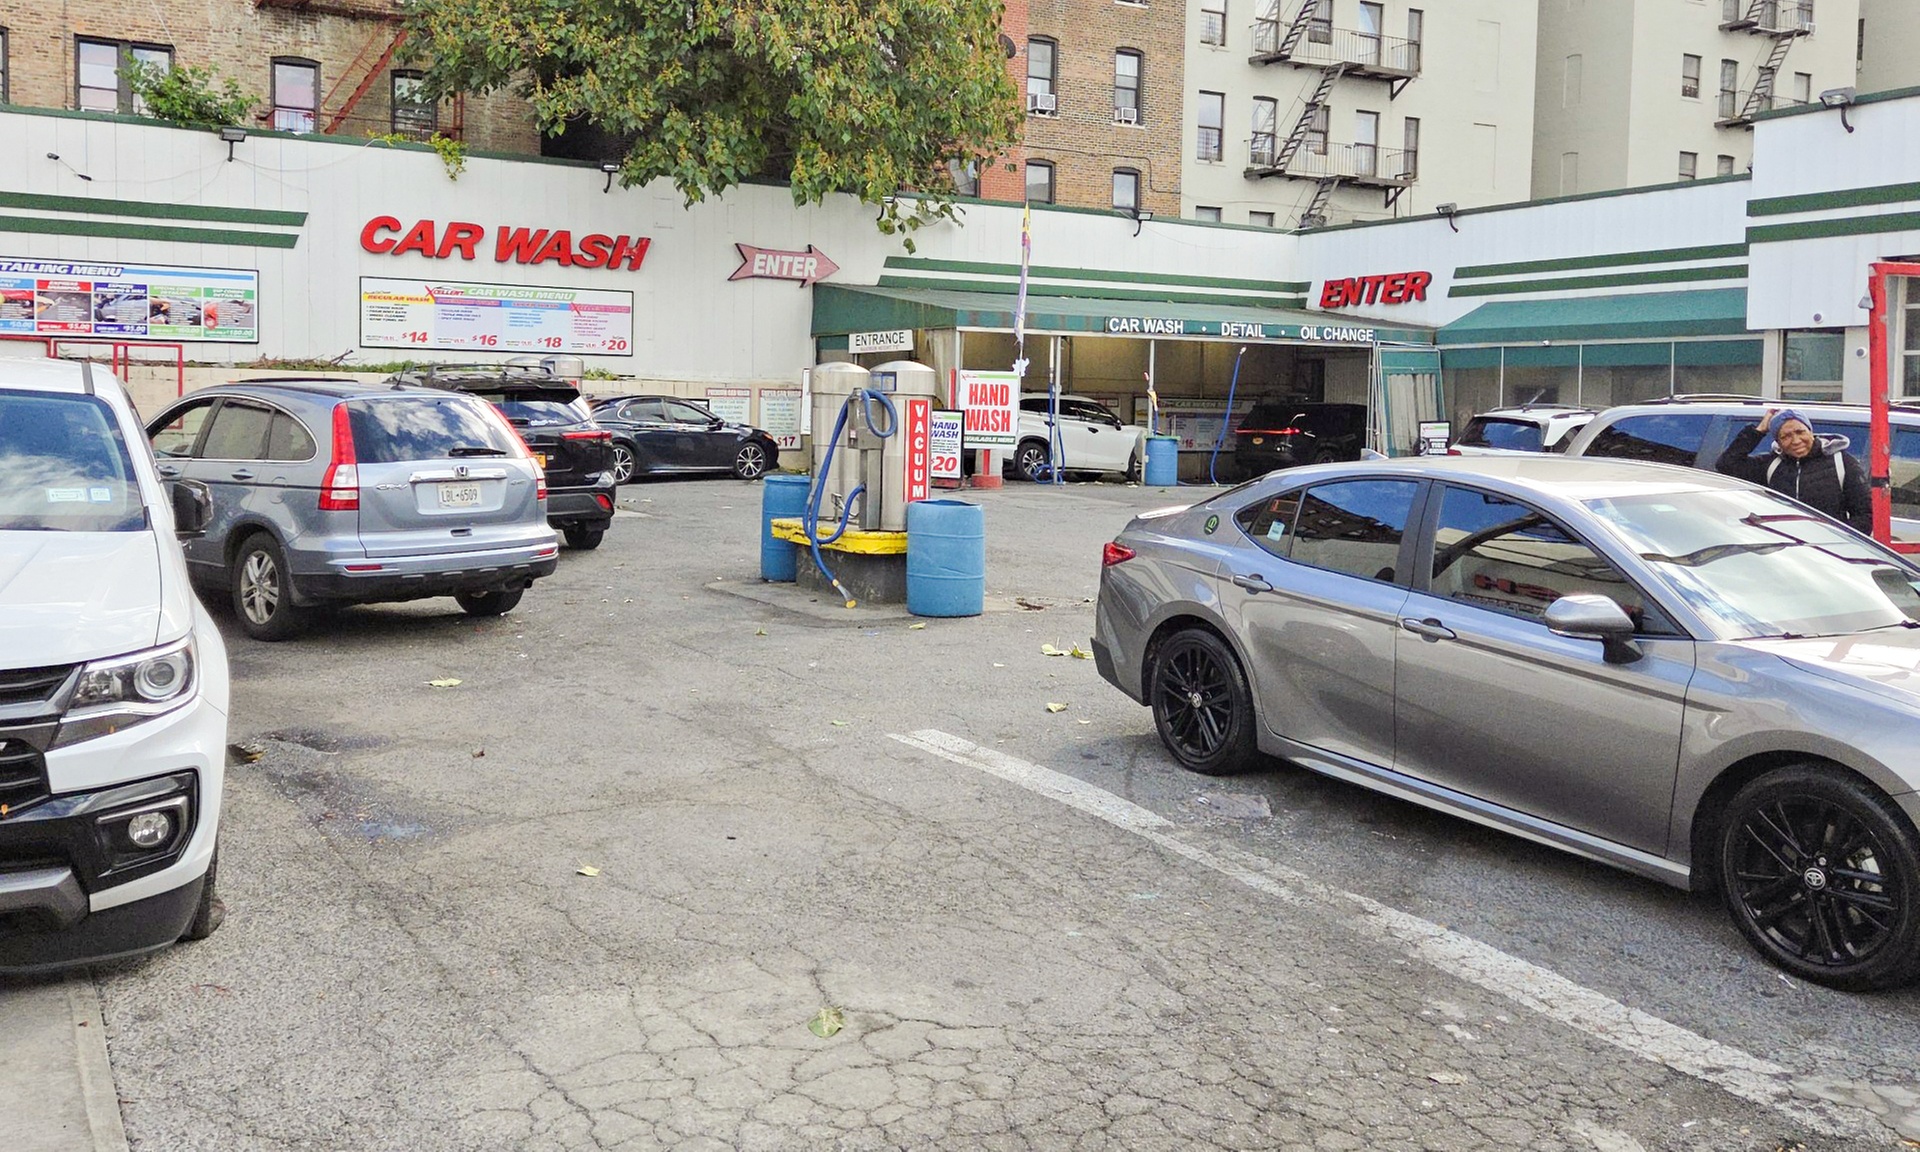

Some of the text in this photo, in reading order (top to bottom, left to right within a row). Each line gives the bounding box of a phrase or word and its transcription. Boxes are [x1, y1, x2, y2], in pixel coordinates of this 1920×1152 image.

[360, 216, 651, 271] CAR WASH
[71, 266, 123, 277] MENU
[753, 253, 818, 278] ENTER
[468, 288, 494, 296] CAR
[496, 289, 534, 298] WASH
[536, 291, 573, 300] MENU
[1319, 271, 1433, 308] ENTER
[1108, 317, 1184, 335] CAR WASH
[1221, 322, 1266, 338] DETAIL
[402, 331, 428, 343] $14
[472, 334, 497, 346] $16
[537, 336, 562, 348] $18
[855, 331, 905, 347] ENTRANCE
[1300, 326, 1374, 343] OIL CHANGE
[601, 339, 627, 351] $20
[969, 383, 1010, 406] HAND
[931, 421, 958, 430] HAND
[965, 409, 1011, 432] WASH
[777, 436, 796, 447] $17
[931, 430, 959, 439] WASH
[912, 404, 925, 498] VACUUM
